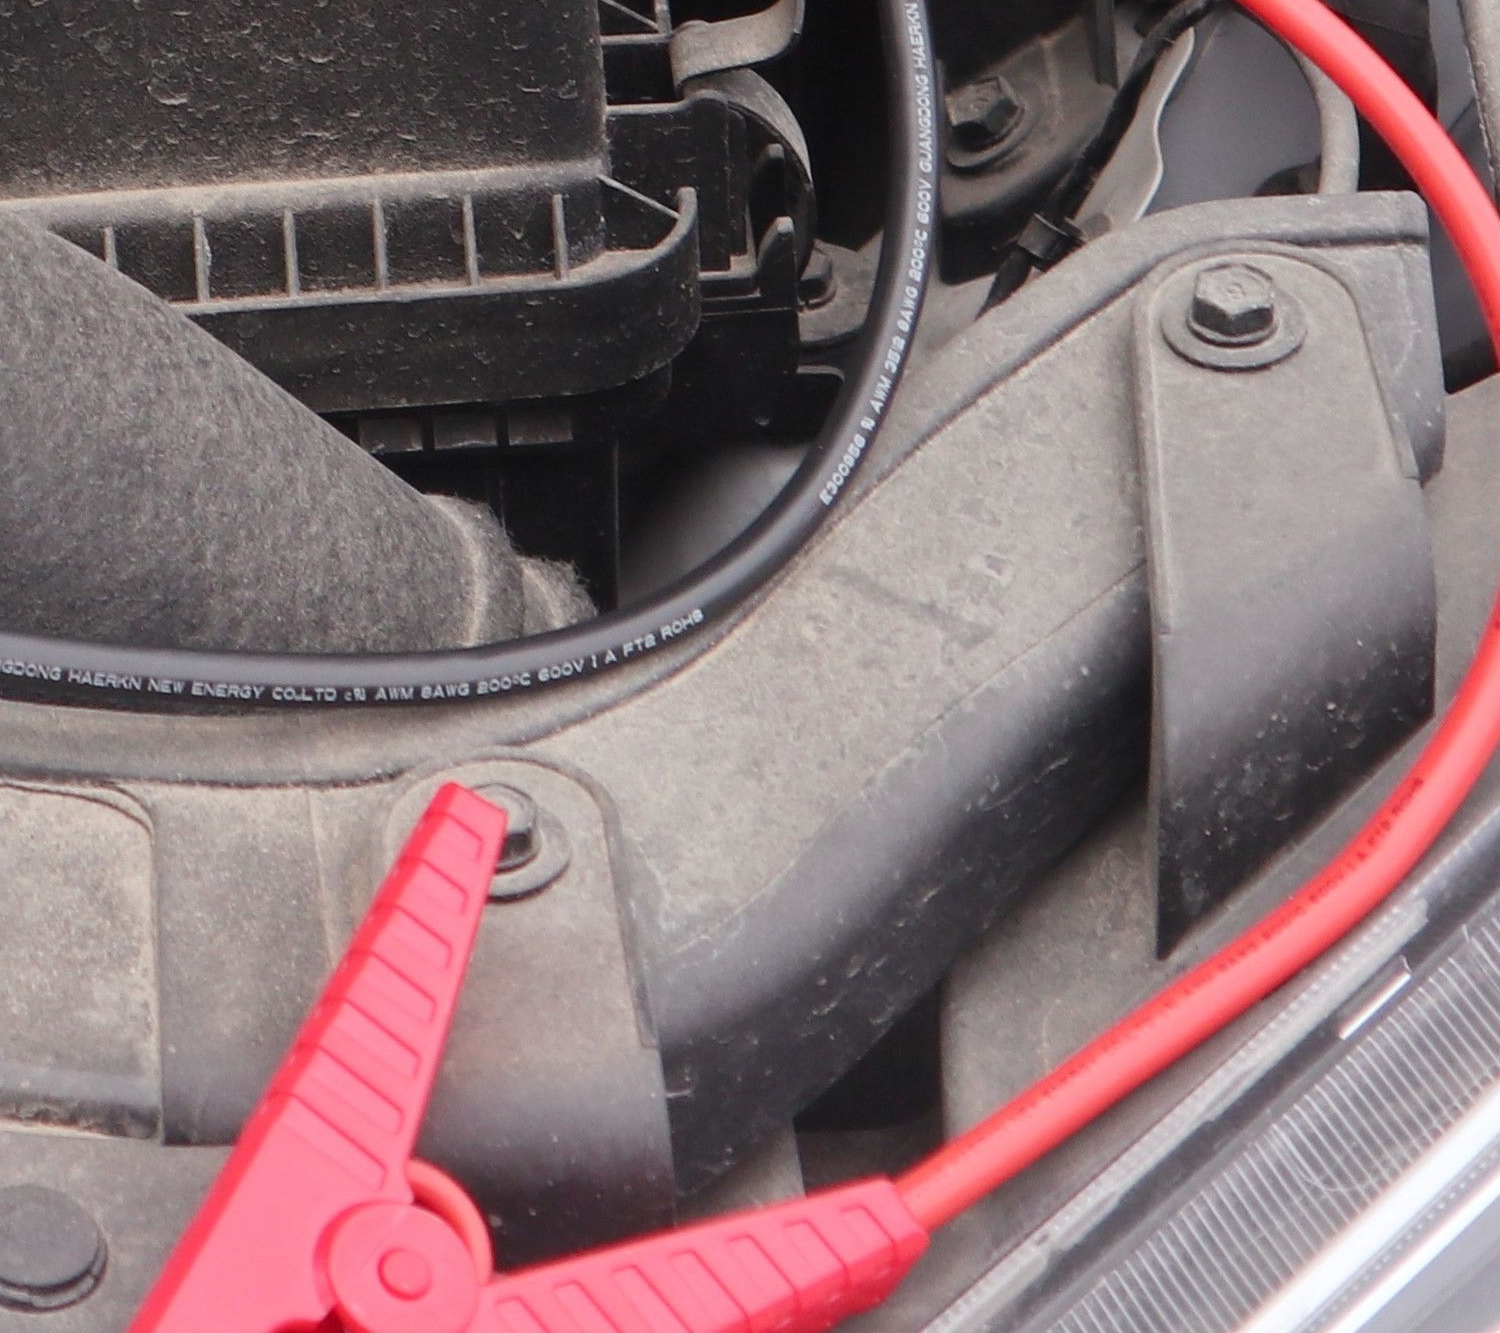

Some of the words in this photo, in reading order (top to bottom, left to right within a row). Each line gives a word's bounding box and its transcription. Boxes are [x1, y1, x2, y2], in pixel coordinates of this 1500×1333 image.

[905, 2, 927, 71] HAERKN
[915, 73, 933, 174] GUANGDONG
[917, 179, 932, 224] 600V
[869, 375, 893, 416] AWM
[66, 668, 143, 692] HAERKN
[146, 677, 187, 695] NEW
[190, 681, 267, 701] ENERGY
[374, 685, 415, 702] AWM
[419, 683, 471, 701] 8AWG
[537, 657, 586, 683] 600V
[604, 648, 618, 665] A
[622, 633, 657, 658] FT2
[659, 608, 704, 641] ROHS
